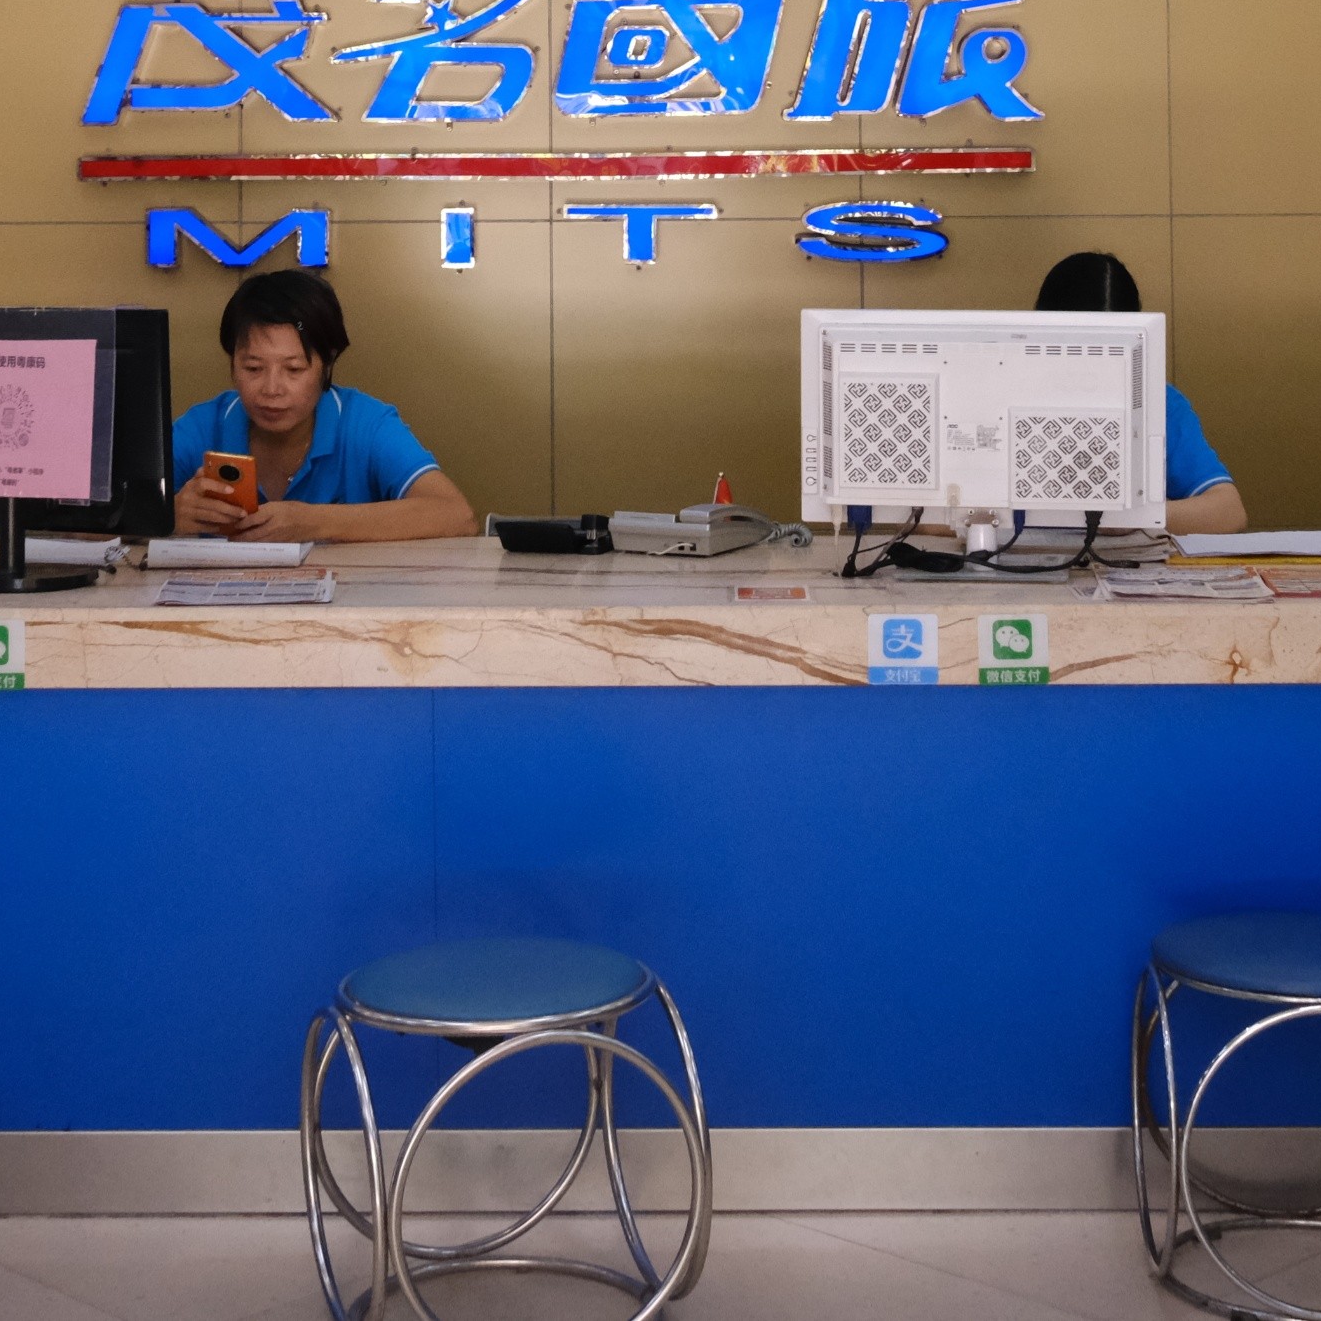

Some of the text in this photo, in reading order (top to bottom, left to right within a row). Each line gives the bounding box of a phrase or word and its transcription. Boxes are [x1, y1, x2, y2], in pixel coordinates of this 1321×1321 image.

[145, 200, 950, 270] MITS
[884, 668, 922, 683] 支付宝
[986, 668, 1042, 683] 微信支付
